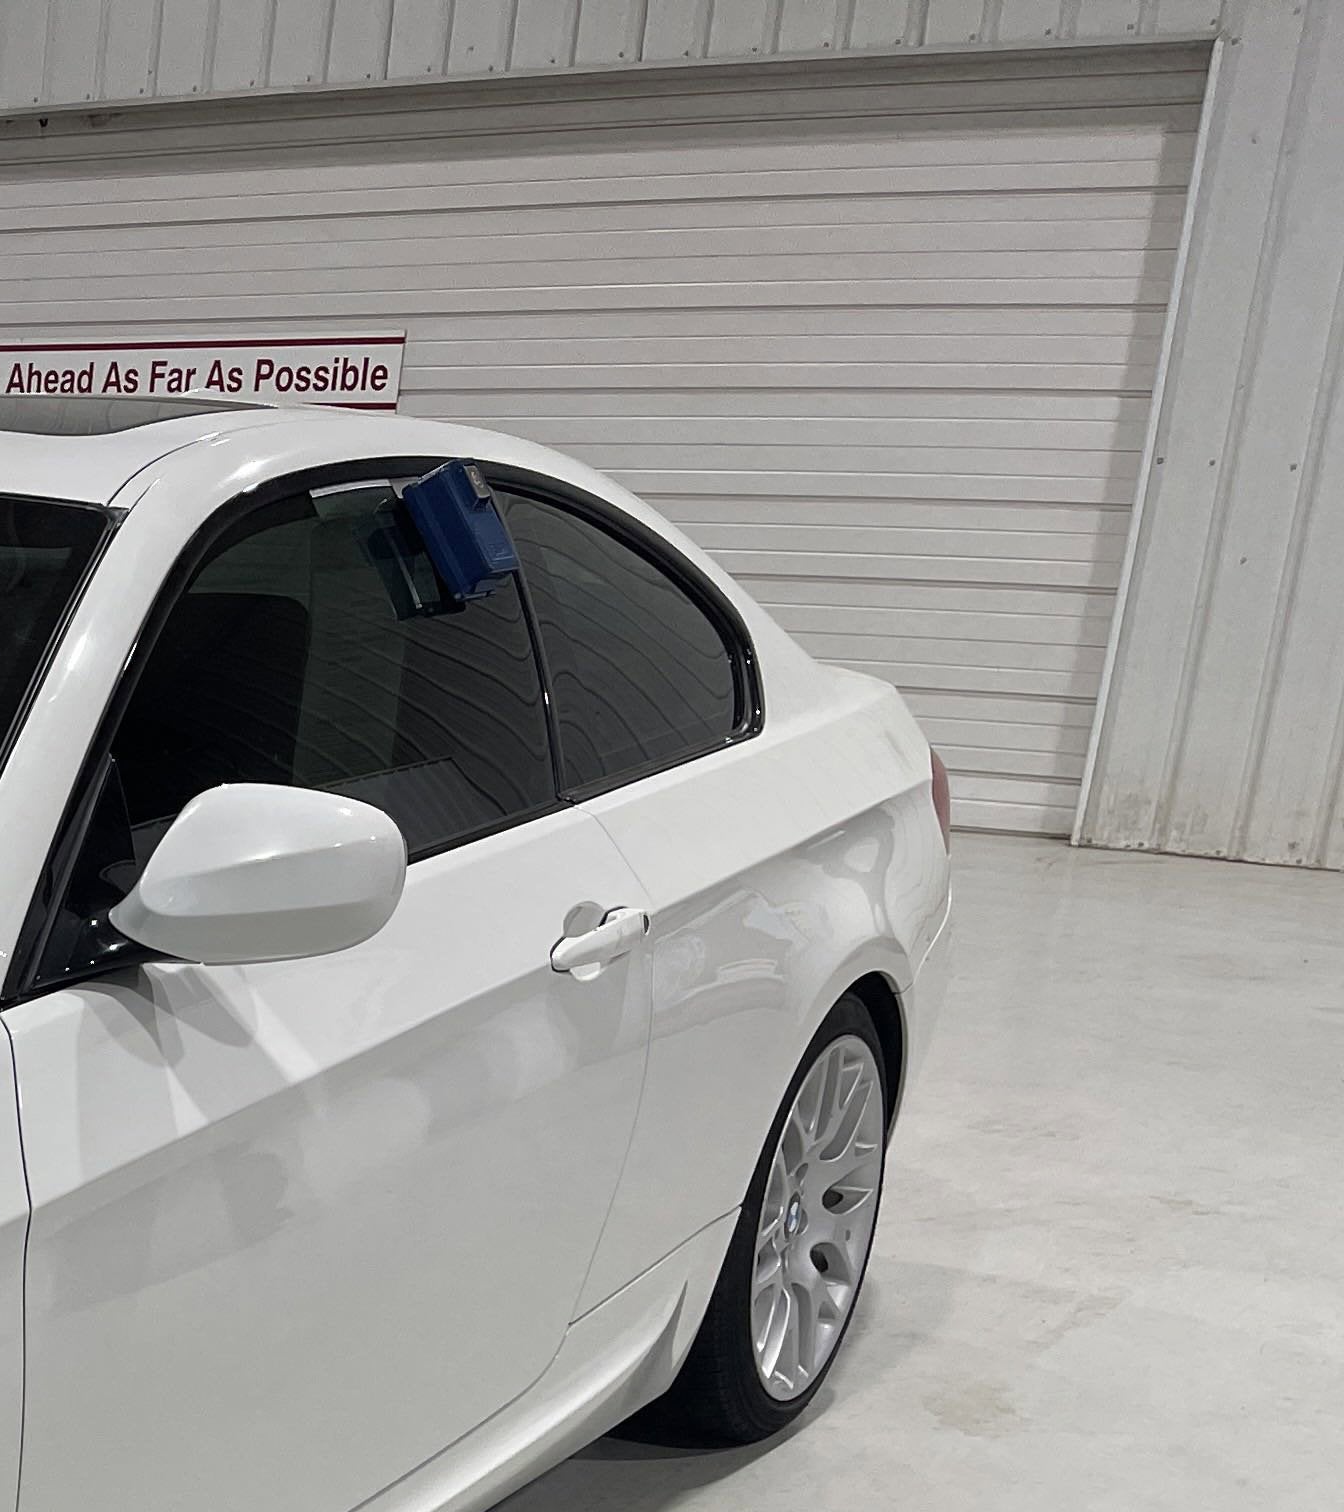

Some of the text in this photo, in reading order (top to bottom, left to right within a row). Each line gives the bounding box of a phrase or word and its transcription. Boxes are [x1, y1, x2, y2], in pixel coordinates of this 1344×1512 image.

[6, 361, 94, 394] Ahead
[102, 361, 139, 394] As
[149, 360, 197, 393] Far
[205, 359, 243, 393] As
[254, 357, 389, 392] Possible
